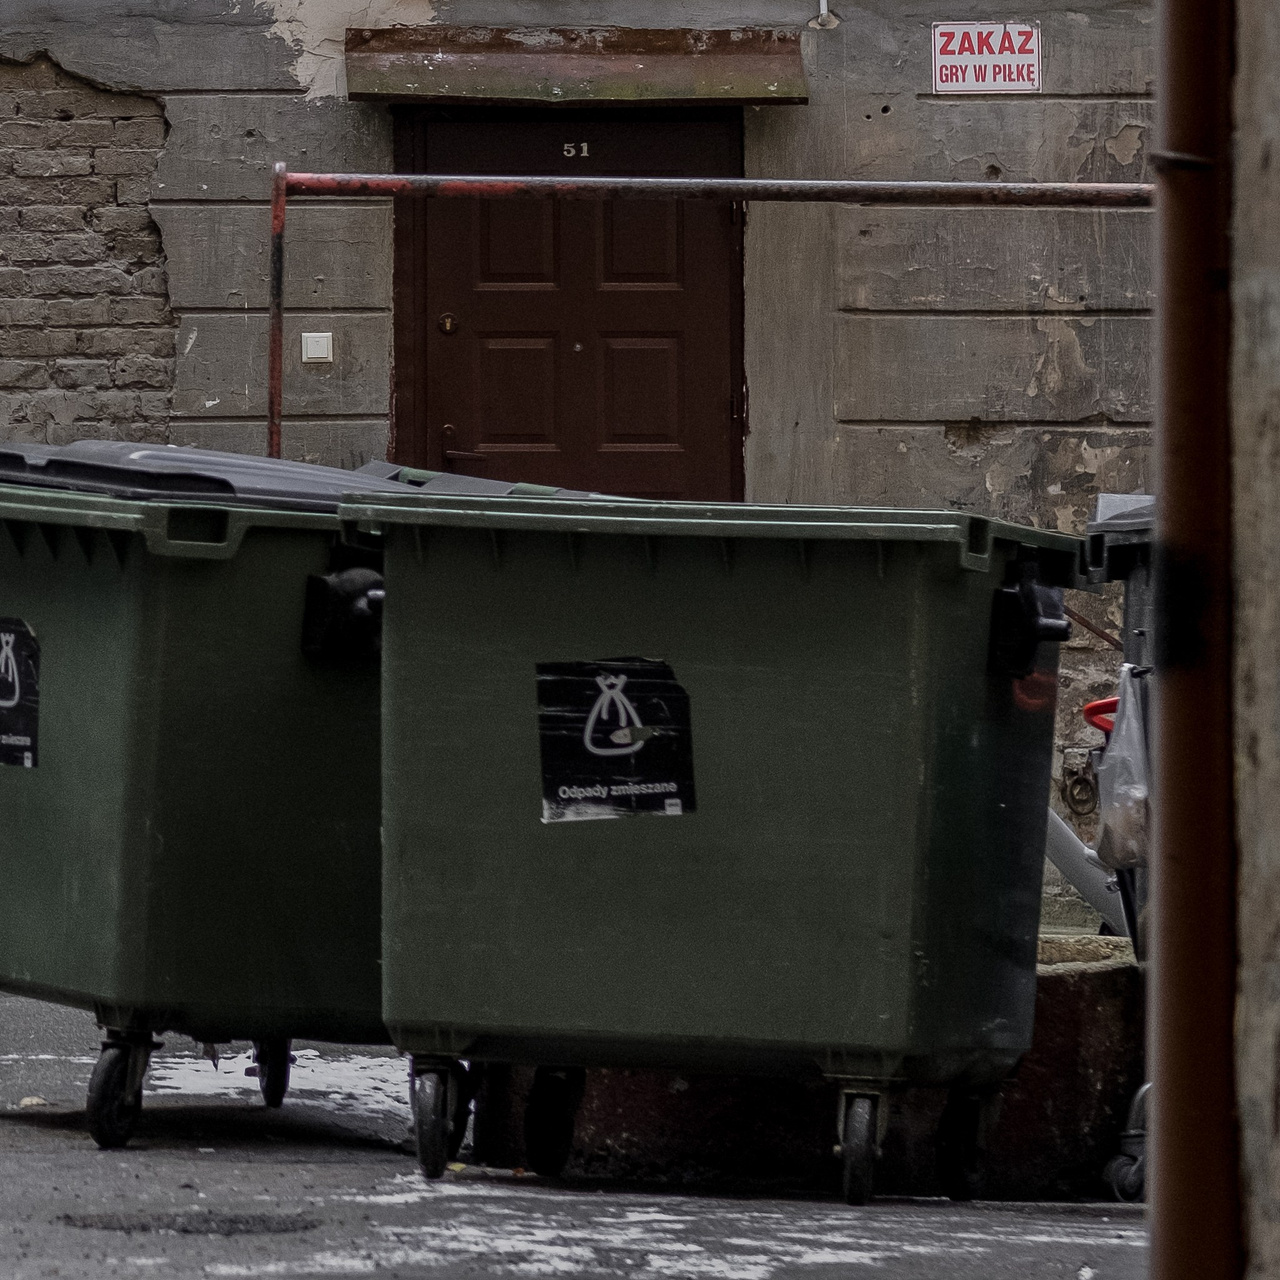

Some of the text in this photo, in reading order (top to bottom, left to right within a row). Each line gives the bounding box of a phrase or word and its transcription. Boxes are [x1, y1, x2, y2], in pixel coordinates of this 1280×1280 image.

[939, 30, 1035, 55] ZAKAZ
[939, 63, 1036, 87] GRY W PIŁKĘ
[563, 142, 589, 157] 51
[558, 782, 678, 799] Odpady zmieszane
